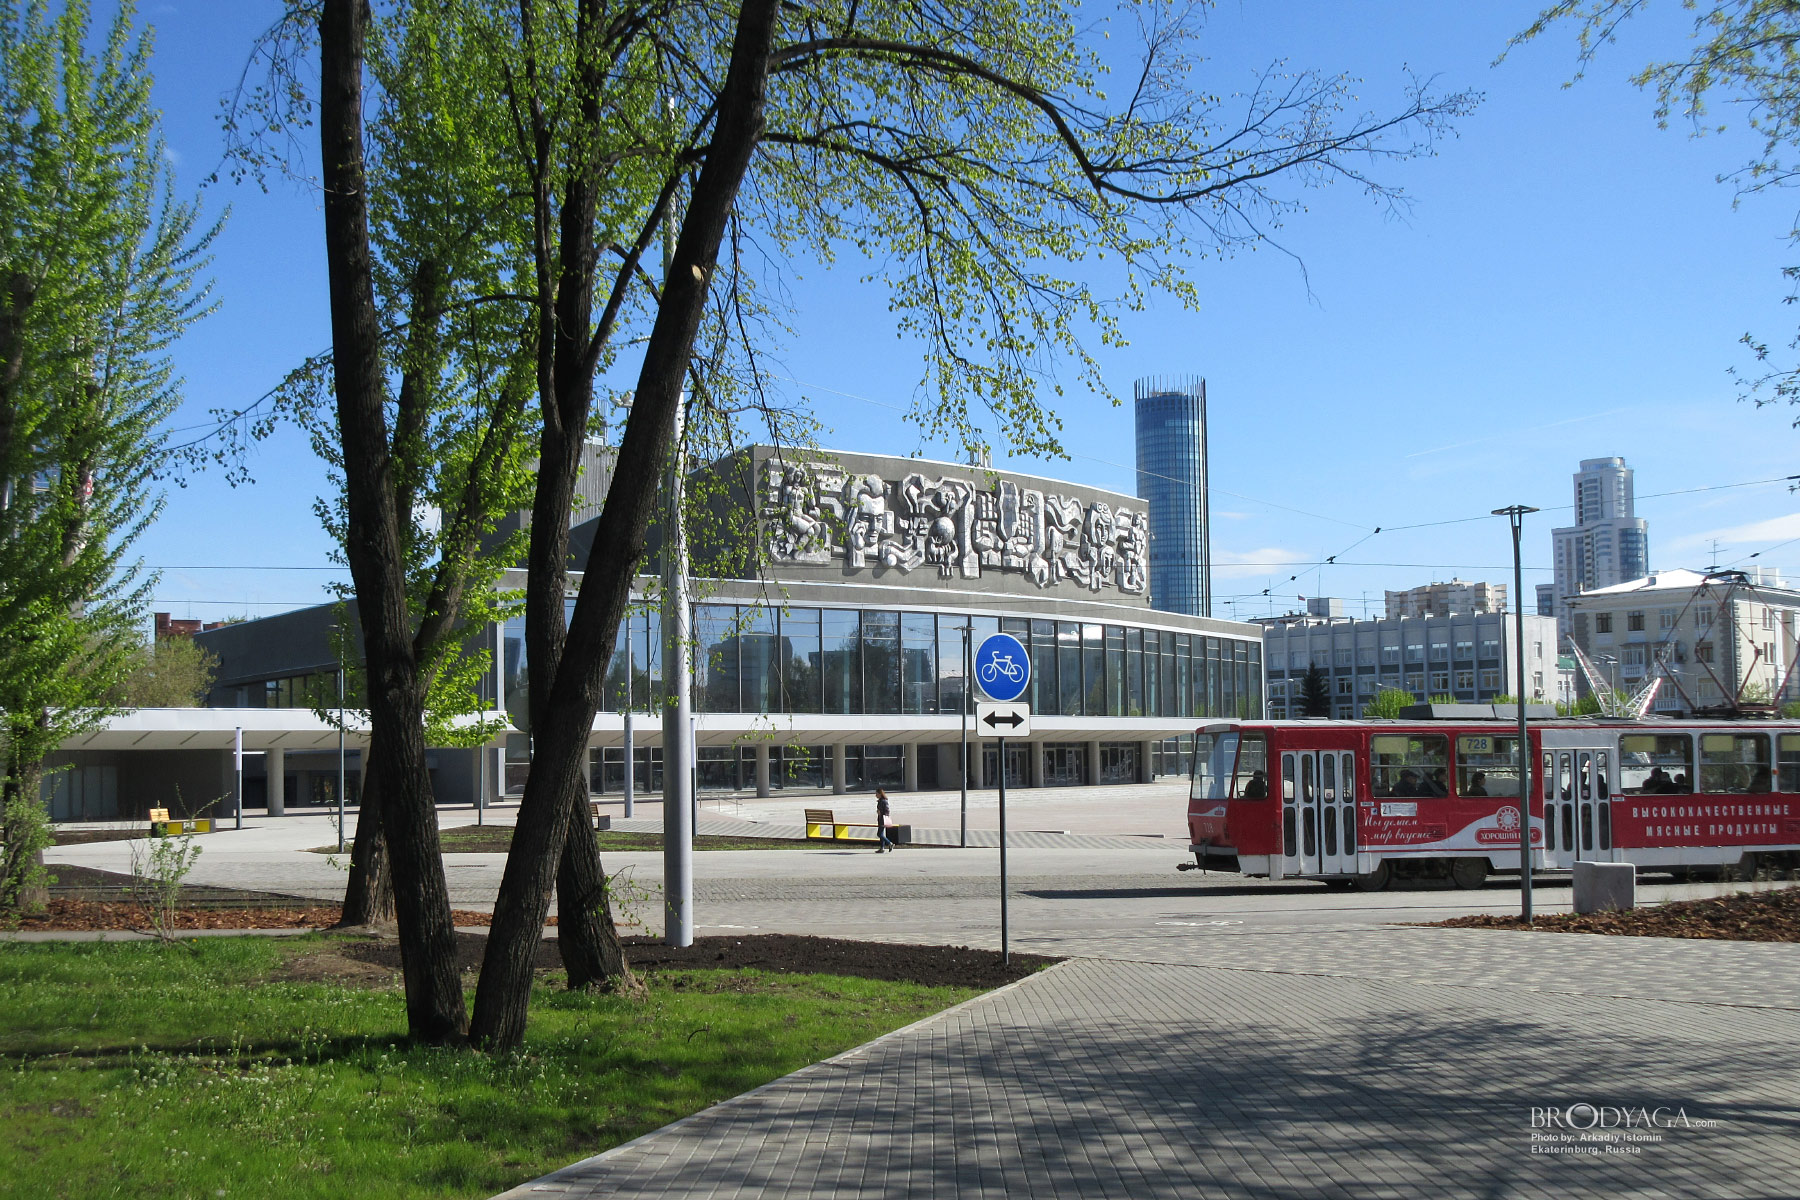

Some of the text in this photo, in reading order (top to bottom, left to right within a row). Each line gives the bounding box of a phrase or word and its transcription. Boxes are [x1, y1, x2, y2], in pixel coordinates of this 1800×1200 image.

[1466, 738, 1488, 750] 728
[1382, 804, 1392, 815] 21
[1632, 804, 1790, 818] ВЫСОКОКАЧЕСТВЕННЫЕ
[1480, 832, 1517, 840] ХОРОШИЙ
[1645, 824, 1777, 837] МЯСНЫЕ ПРОДУКТЫ
